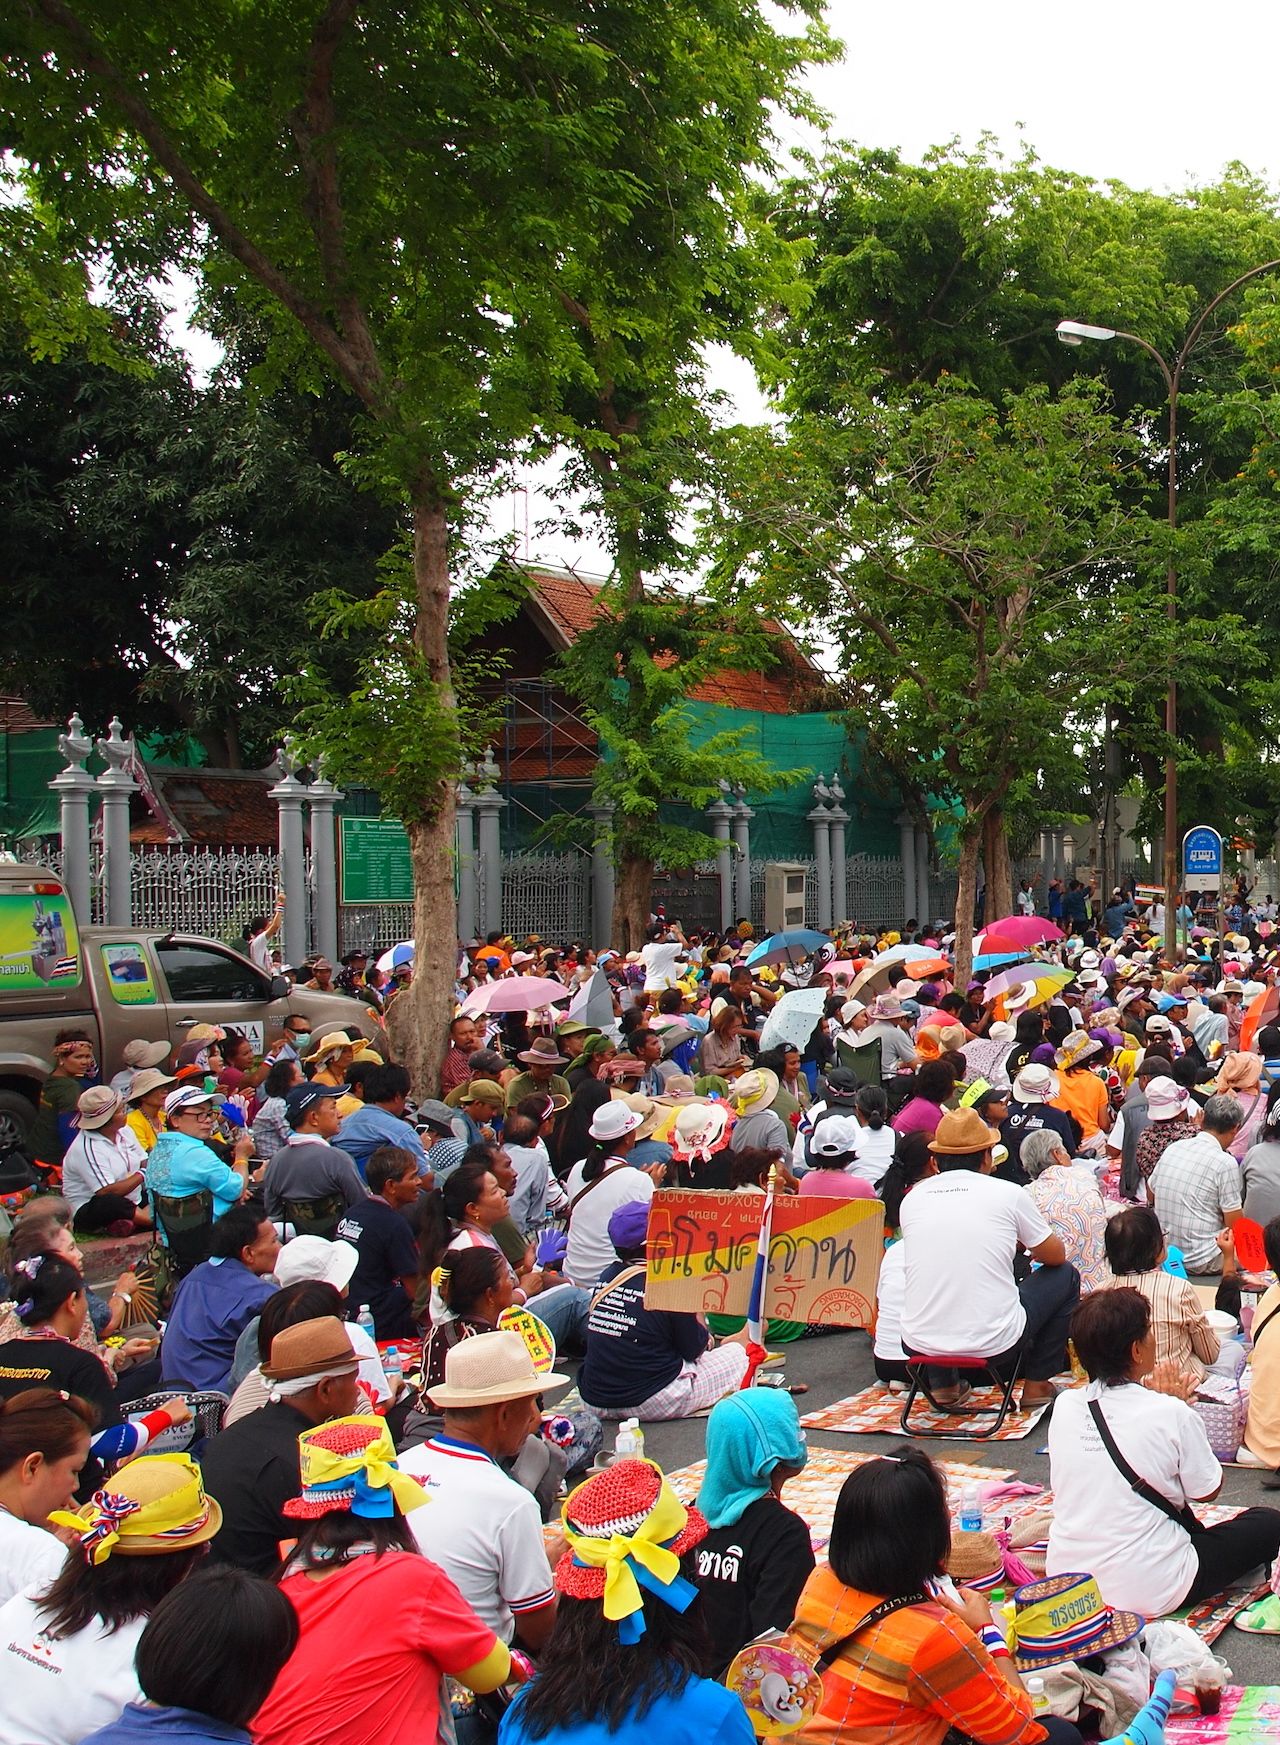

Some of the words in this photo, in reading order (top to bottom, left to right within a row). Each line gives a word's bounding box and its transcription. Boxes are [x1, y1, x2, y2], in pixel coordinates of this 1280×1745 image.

[720, 1212, 732, 1228] 7
[819, 1290, 864, 1308] PACKAGING
[820, 1302, 859, 1319] PACK
